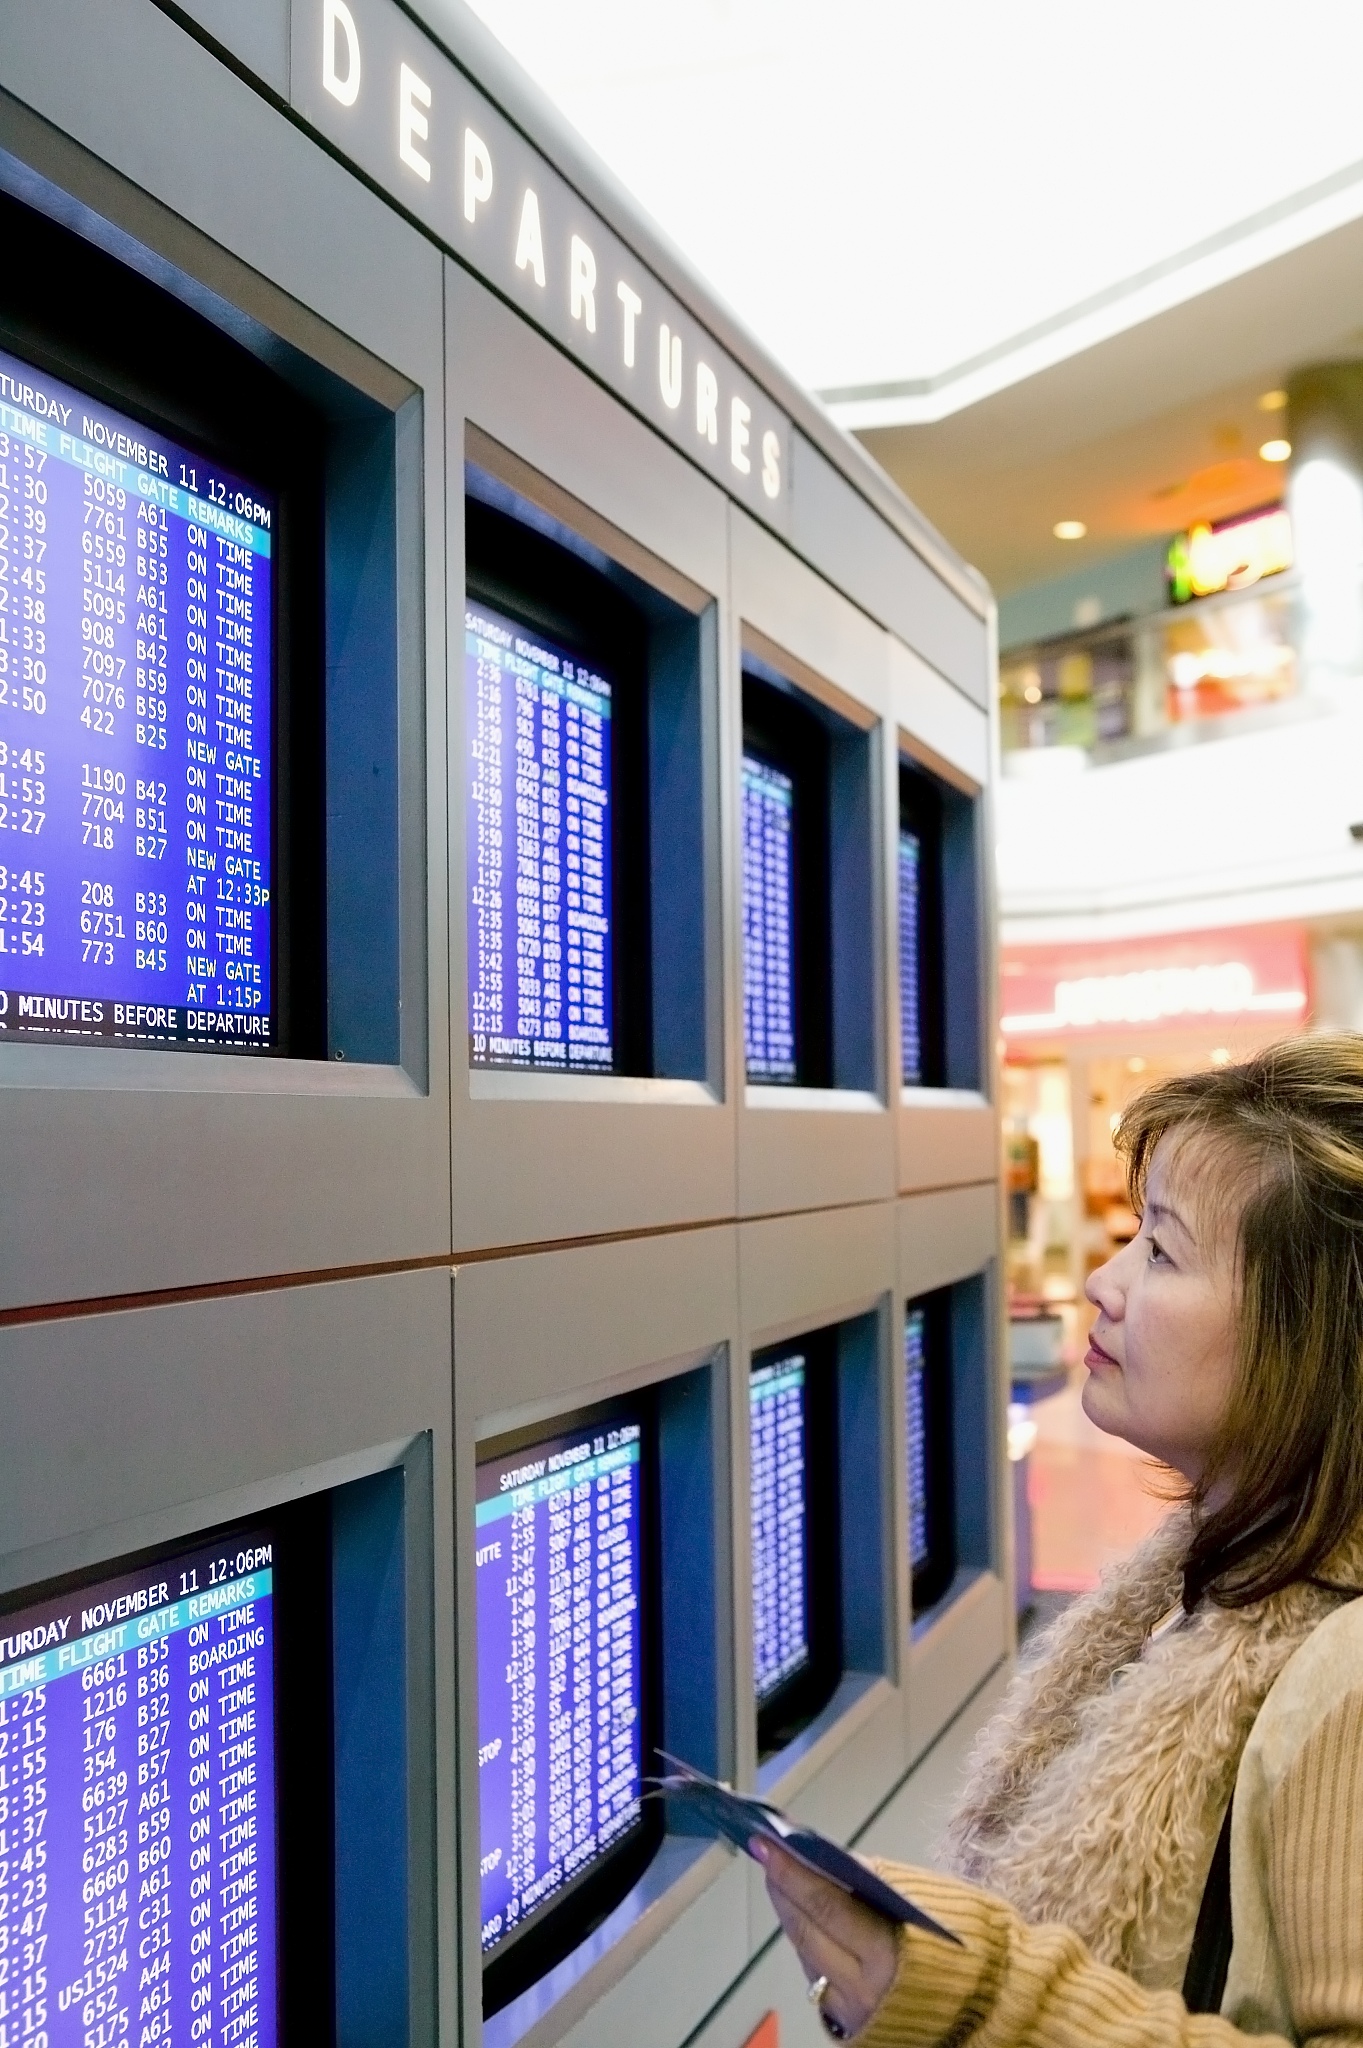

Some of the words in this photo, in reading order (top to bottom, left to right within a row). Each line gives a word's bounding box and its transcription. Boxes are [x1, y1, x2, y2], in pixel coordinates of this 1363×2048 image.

[323, 0, 782, 499] DEPARTURES
[0, 402, 47, 446] TIME
[60, 433, 127, 482] FLIGHT
[137, 472, 178, 509] GATE
[188, 496, 253, 544] REMARKS
[83, 415, 168, 477] NOVEMBER
[179, 464, 198, 492] 11
[209, 479, 270, 529] 12:06PM
[83, 501, 126, 541] 7761
[137, 527, 167, 558] B55
[187, 550, 207, 576] ON
[216, 562, 253, 596] TIME
[84, 472, 126, 511] 5059
[137, 501, 168, 532] A61
[188, 524, 207, 550] ON
[216, 536, 253, 571] TIME
[82, 530, 125, 567] 6559
[137, 554, 167, 585] B53
[187, 577, 206, 603] ON
[216, 588, 253, 622] TIME
[84, 559, 125, 596] 5114
[136, 584, 168, 614] A61
[187, 604, 206, 629] ON
[216, 615, 253, 648] TIME
[82, 617, 114, 649] 908
[137, 639, 167, 668] B42
[187, 658, 206, 683] ON
[216, 667, 252, 699] TIME
[84, 588, 125, 624] 5095
[136, 612, 167, 641] A61
[187, 631, 206, 656] ON
[216, 641, 253, 673] TIME
[82, 646, 126, 680] 7097
[137, 667, 166, 695] B59
[187, 685, 206, 709] ON
[216, 694, 252, 724] TIME
[82, 675, 125, 709] 7076
[136, 694, 166, 722] B59
[187, 712, 206, 736] ON
[216, 720, 252, 750] TIME
[80, 705, 114, 735] 422
[136, 723, 166, 750] B25
[187, 738, 217, 765] NEW
[226, 750, 261, 778] GATE
[187, 766, 206, 789] ON
[216, 773, 252, 802] TIME
[82, 763, 125, 795] 1190
[136, 779, 166, 806] B42
[187, 793, 205, 816] ON
[216, 800, 252, 827] TIME
[82, 792, 124, 823] 7704
[136, 807, 167, 833] B51
[187, 820, 205, 842] ON
[215, 826, 252, 853] TIME
[82, 821, 114, 849] 718
[136, 835, 167, 860] B27
[187, 846, 216, 871] NEW
[225, 855, 261, 881] GATE
[187, 874, 206, 895] AT
[217, 878, 270, 907] 12:33P
[81, 910, 125, 938] 6751
[136, 920, 167, 944] B60
[187, 929, 205, 950] ON
[215, 932, 252, 956] TIME
[82, 880, 114, 907] 208
[136, 892, 166, 916] B33
[187, 901, 205, 923] ON
[215, 906, 252, 931] TIME
[81, 939, 114, 965] 773
[136, 948, 166, 971] B45
[187, 955, 217, 978] NEW
[226, 961, 261, 983] GATE
[187, 983, 206, 1003] AT
[217, 984, 261, 1008] 1:15P
[19, 995, 104, 1022] MINUTES
[114, 1004, 177, 1028] BEFORE
[187, 1010, 270, 1035] DEPARTURE
[473, 1034, 486, 1052] 10
[500, 1460, 546, 1491] SATURDAY
[81, 1582, 169, 1632] NOVEMBER
[180, 1569, 199, 1595] 11
[209, 1544, 272, 1585] 12:06PM
[0, 1656, 46, 1694] TIME
[59, 1625, 127, 1670] FLIGHT
[137, 1605, 179, 1639] GATE
[189, 1577, 254, 1619] REMARKS
[82, 1653, 127, 1691] 6661
[138, 1635, 169, 1669] B55
[188, 1622, 208, 1647] ON
[218, 1603, 255, 1635] TIME
[83, 1682, 127, 1722] 1216
[138, 1664, 169, 1698] B36
[189, 1626, 264, 1676] BOARDING
[83, 1716, 116, 1753] 176
[138, 1693, 169, 1727] B32
[189, 1677, 209, 1703] ON
[218, 1656, 255, 1689] TIME
[84, 1746, 116, 1782] 354
[138, 1720, 170, 1756] B27
[189, 1704, 209, 1731] ON
[218, 1683, 256, 1716] TIME
[82, 1771, 127, 1812] 6639
[138, 1748, 170, 1785] B57
[189, 1732, 209, 1759] ON
[218, 1709, 256, 1744] TIME
[84, 1798, 128, 1843] 5127
[138, 1778, 171, 1815] A61
[189, 1760, 209, 1787] ON
[218, 1736, 256, 1771] TIME
[82, 1829, 128, 1873] 6283
[139, 1807, 170, 1844] B59
[190, 1787, 210, 1815] ON
[219, 1763, 256, 1798] TIME
[82, 1859, 129, 1904] 6660
[139, 1835, 171, 1873] B60
[190, 1815, 210, 1843] ON
[219, 1789, 257, 1826] TIME
[83, 1917, 129, 1966] 2737
[139, 1893, 171, 1930] C31
[190, 1870, 210, 1899] ON
[219, 1843, 257, 1880] TIME
[84, 1888, 128, 1935] 5114
[138, 1864, 171, 1903] A61
[190, 1843, 210, 1871] ON
[219, 1816, 257, 1853] TIME
[58, 1948, 128, 2011] US1524
[139, 1922, 171, 1959] C31
[190, 1898, 210, 1927] ON
[219, 1869, 257, 1908] TIME
[83, 1985, 117, 2026] 652
[139, 1950, 171, 1991] A44
[191, 1926, 211, 1955] ON
[220, 1896, 258, 1935] TIME
[84, 2006, 129, 2048] 5175
[139, 1980, 172, 2021] A61
[191, 1954, 211, 1984] ON
[220, 1923, 258, 1963] TIME
